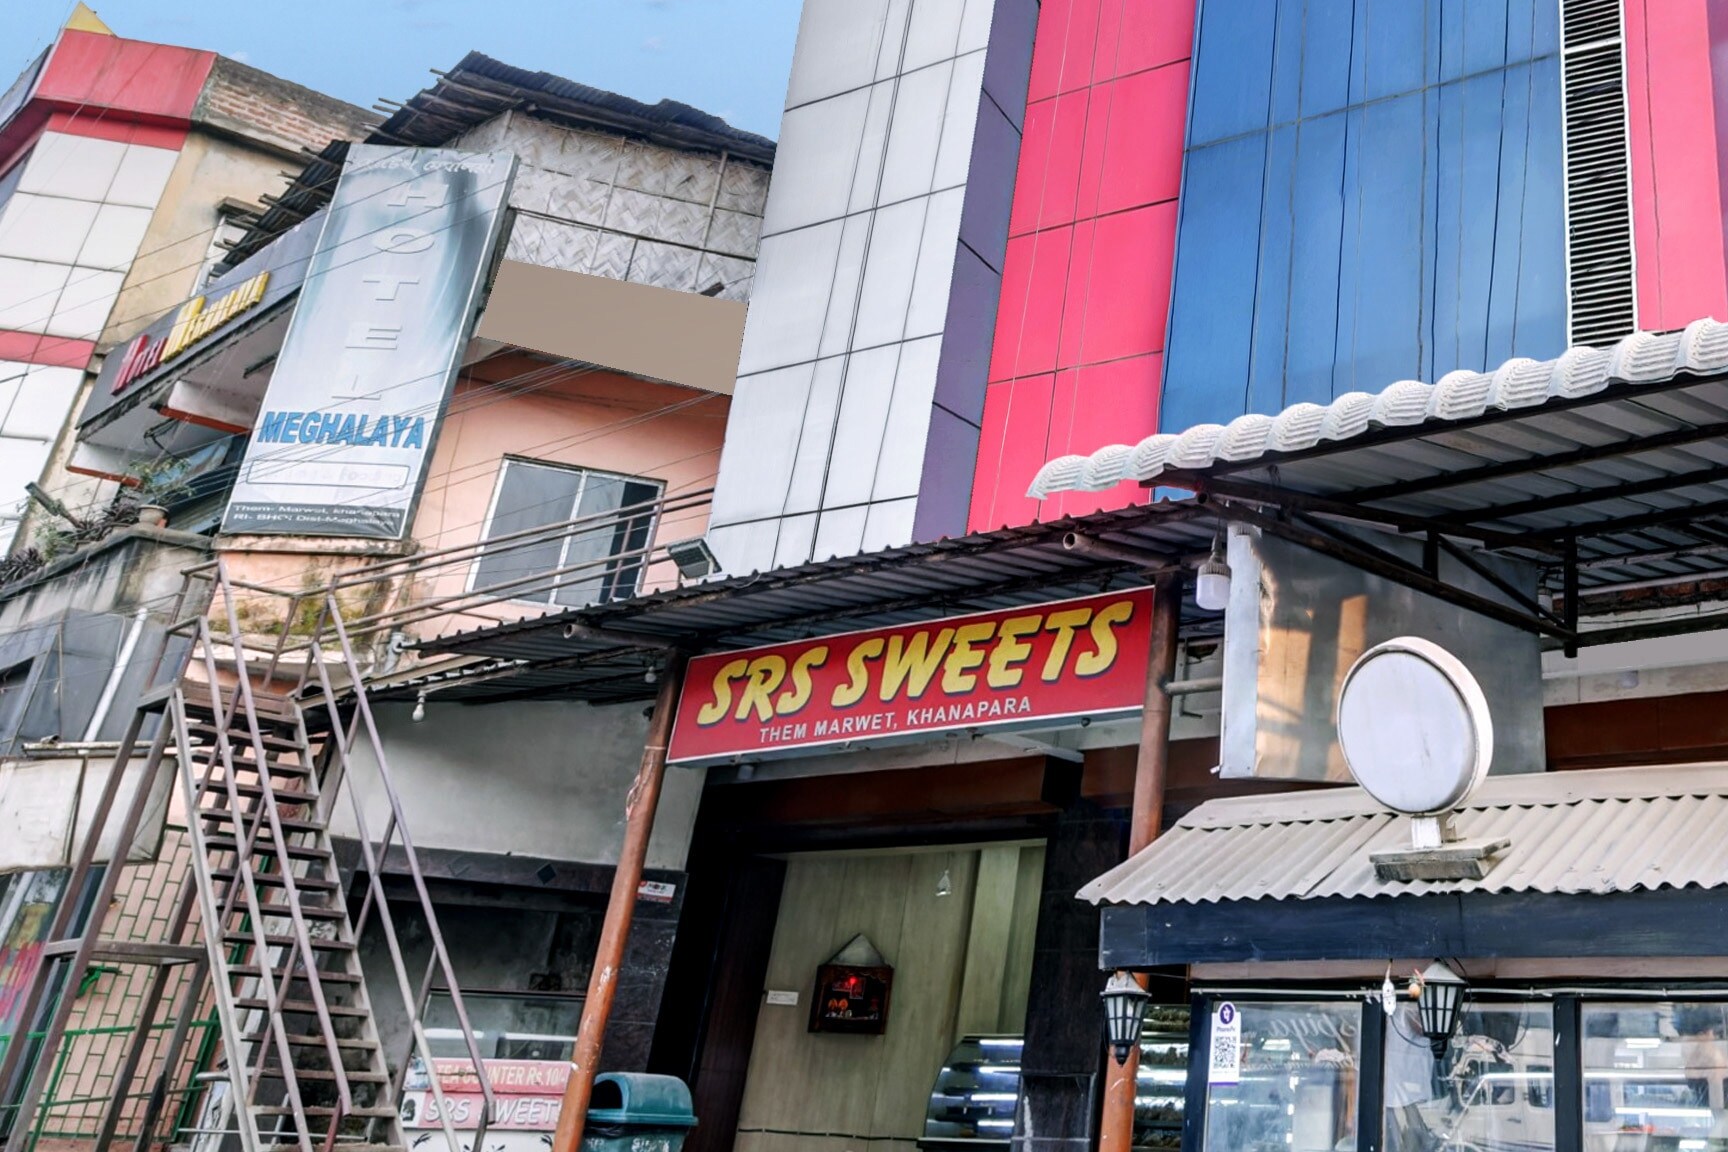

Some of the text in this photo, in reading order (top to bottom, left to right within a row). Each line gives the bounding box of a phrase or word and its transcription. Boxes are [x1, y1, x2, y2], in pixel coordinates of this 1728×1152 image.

[330, 181, 450, 402] HOTEL
[257, 410, 425, 449] MEGHALAYA
[697, 600, 1134, 725] SRS SWEETS
[760, 695, 1032, 743] THEM MARWET, KHANAPARA
[478, 1097, 563, 1124] WEET
